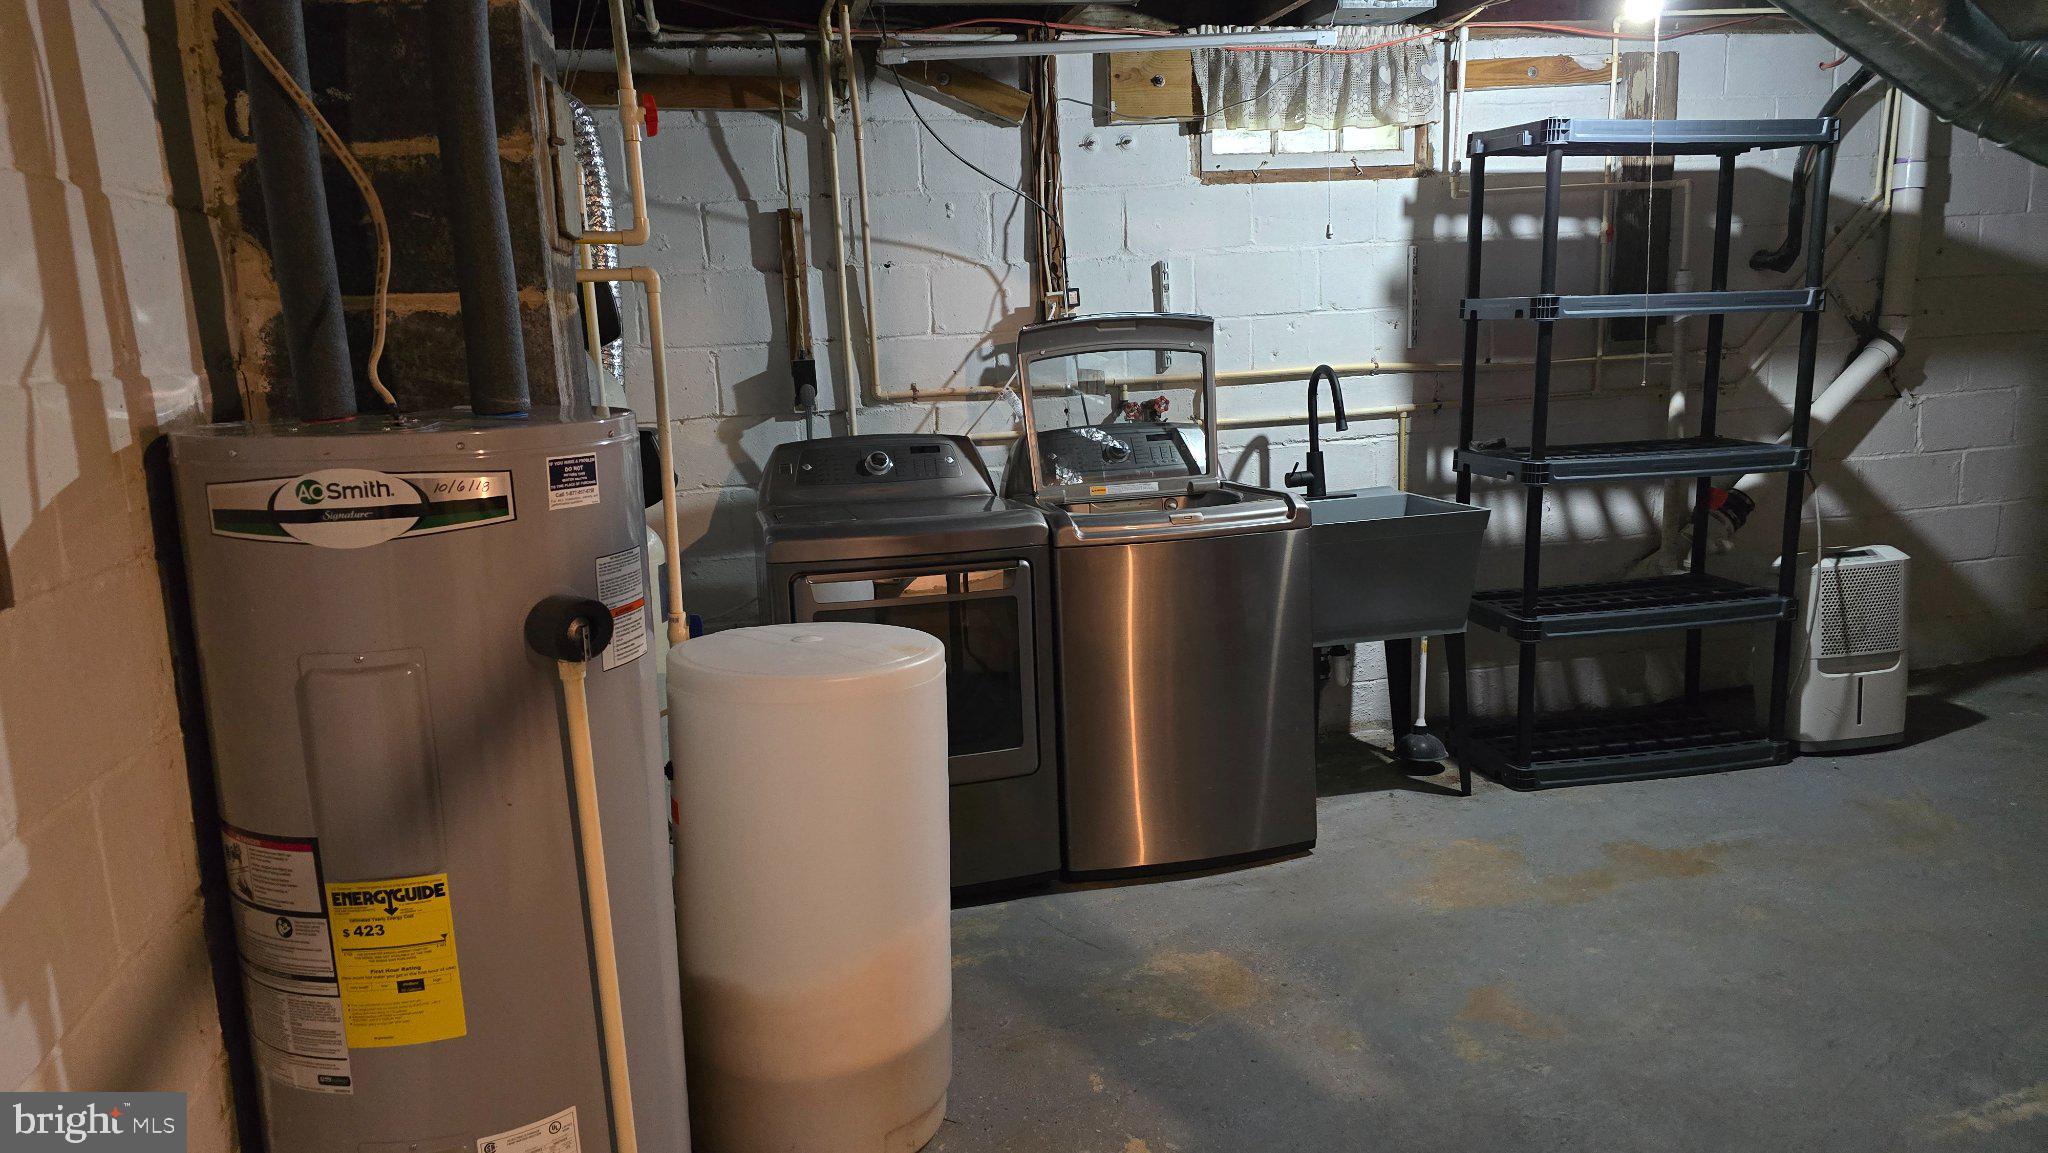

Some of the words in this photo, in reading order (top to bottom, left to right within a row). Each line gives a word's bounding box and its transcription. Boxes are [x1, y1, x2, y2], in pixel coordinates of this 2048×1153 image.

[322, 509, 374, 521] Signature
[331, 882, 446, 908] ENERGYGUIDE
[342, 928, 350, 938] $
[353, 924, 385, 937] 423
